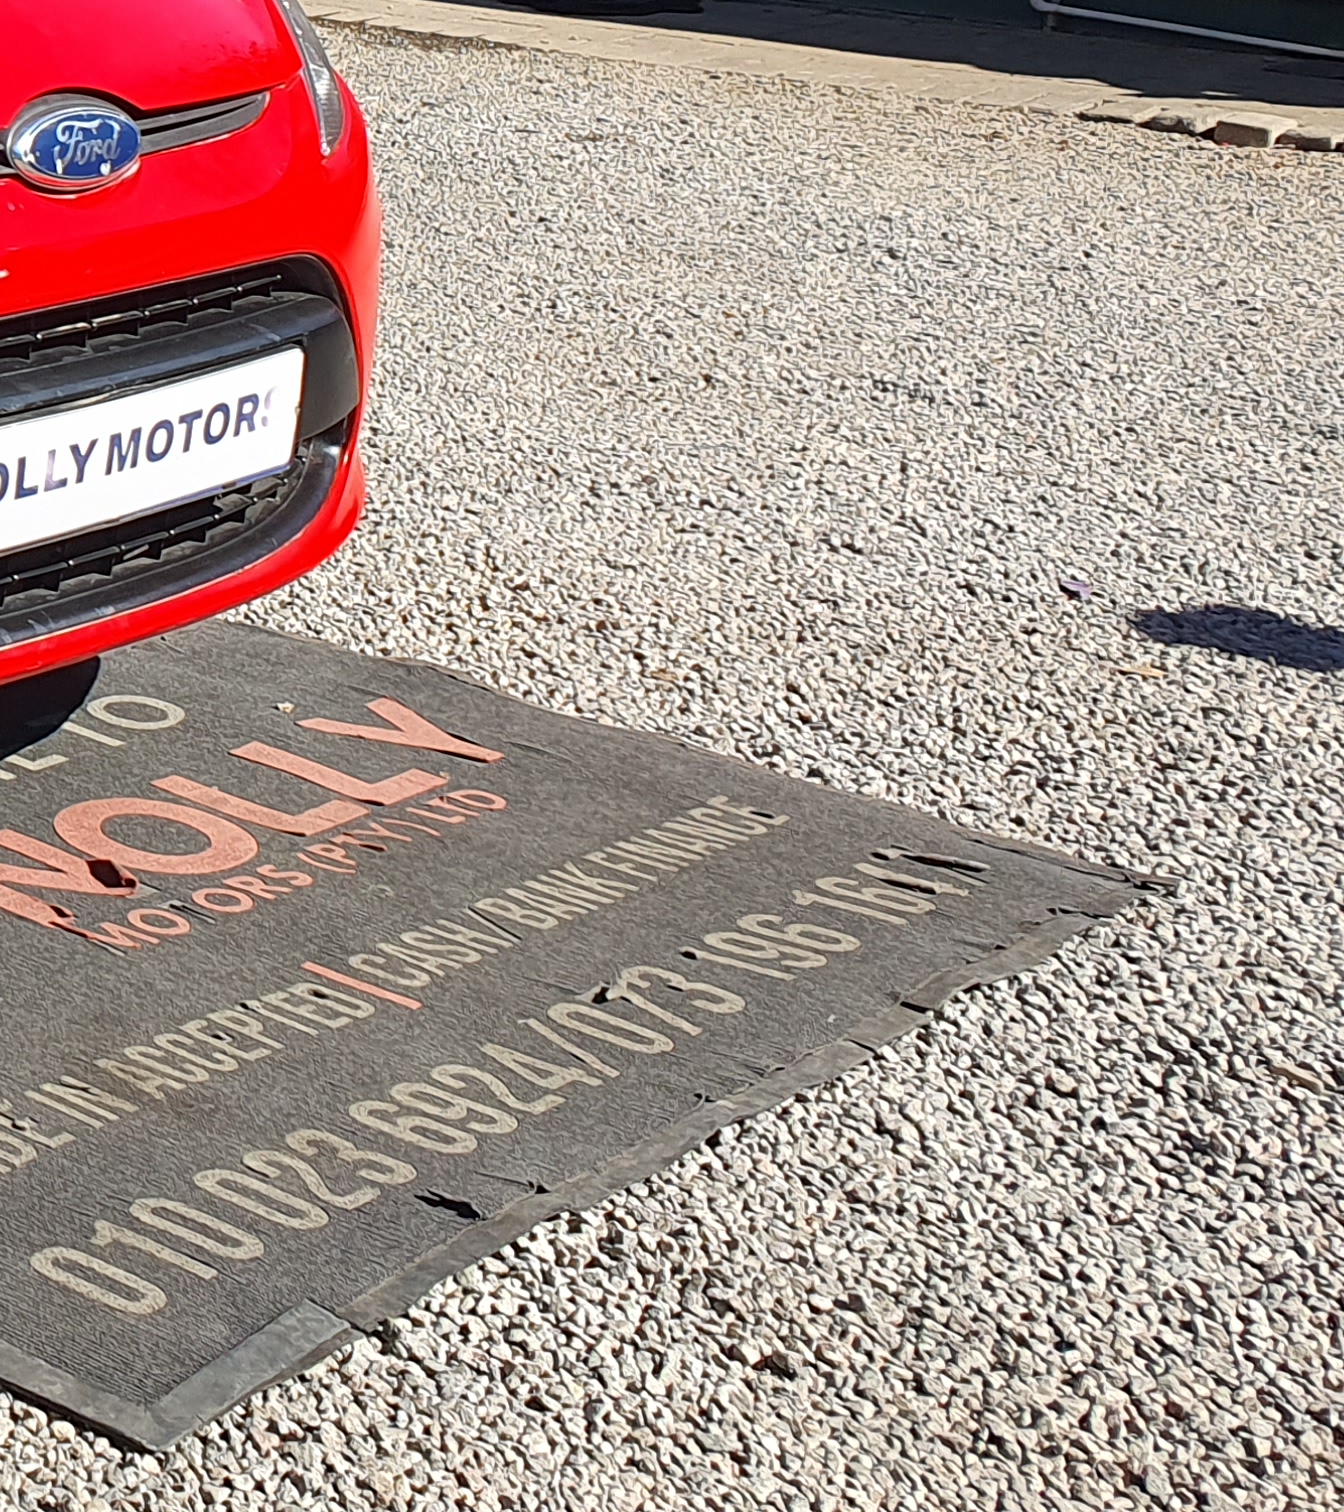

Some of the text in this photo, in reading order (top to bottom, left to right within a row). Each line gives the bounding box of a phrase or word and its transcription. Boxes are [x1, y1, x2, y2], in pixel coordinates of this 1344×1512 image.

[53, 118, 121, 168] Ford
[23, 1075, 141, 1130] IN
[93, 982, 376, 1101] ACCEPTED
[348, 861, 640, 988] CASH/BANK
[582, 794, 791, 883] FINANCE
[29, 1197, 265, 1316] 010
[193, 1128, 417, 1232] 023
[348, 963, 746, 1156] 6924/073
[679, 913, 862, 982] 196
